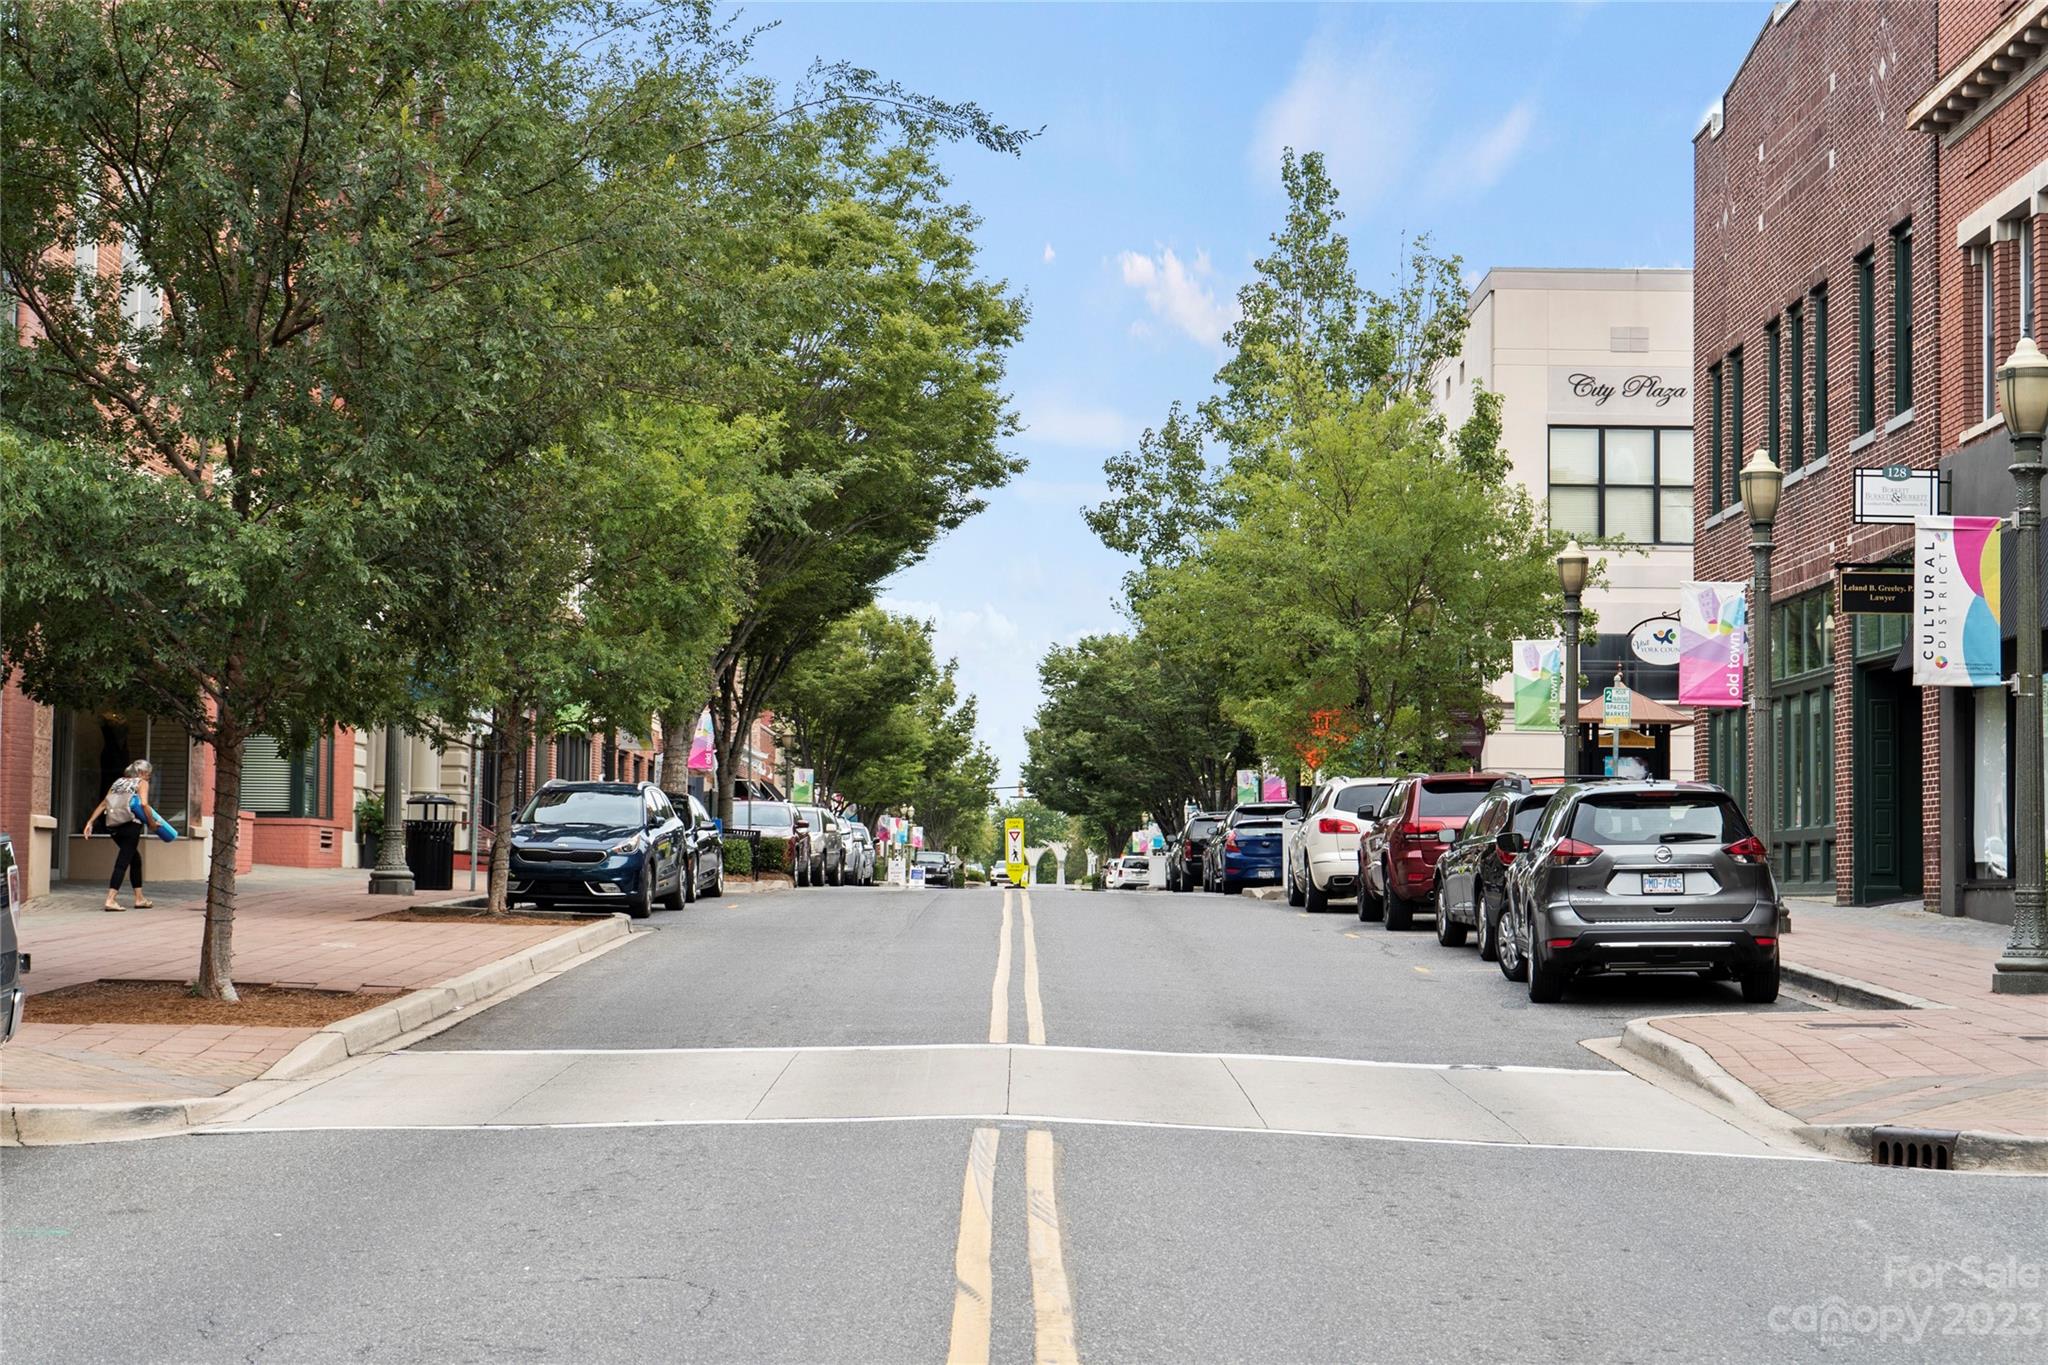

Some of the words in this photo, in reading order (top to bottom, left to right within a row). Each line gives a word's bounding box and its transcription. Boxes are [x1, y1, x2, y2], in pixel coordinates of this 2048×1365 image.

[1567, 373, 1616, 407] City
[1622, 374, 1687, 407] Plaza
[1887, 467, 1907, 478] 128
[1843, 584, 1868, 592] Leland
[1870, 594, 1896, 603] Lawyer
[1923, 542, 1935, 660] CULTURAL
[1938, 553, 1948, 649] DISTRICT
[1727, 632, 1740, 668] town
[1550, 675, 1558, 703] town
[1606, 690, 1612, 701] 2
[1726, 673, 1739, 696] old
[1548, 706, 1558, 724] old
